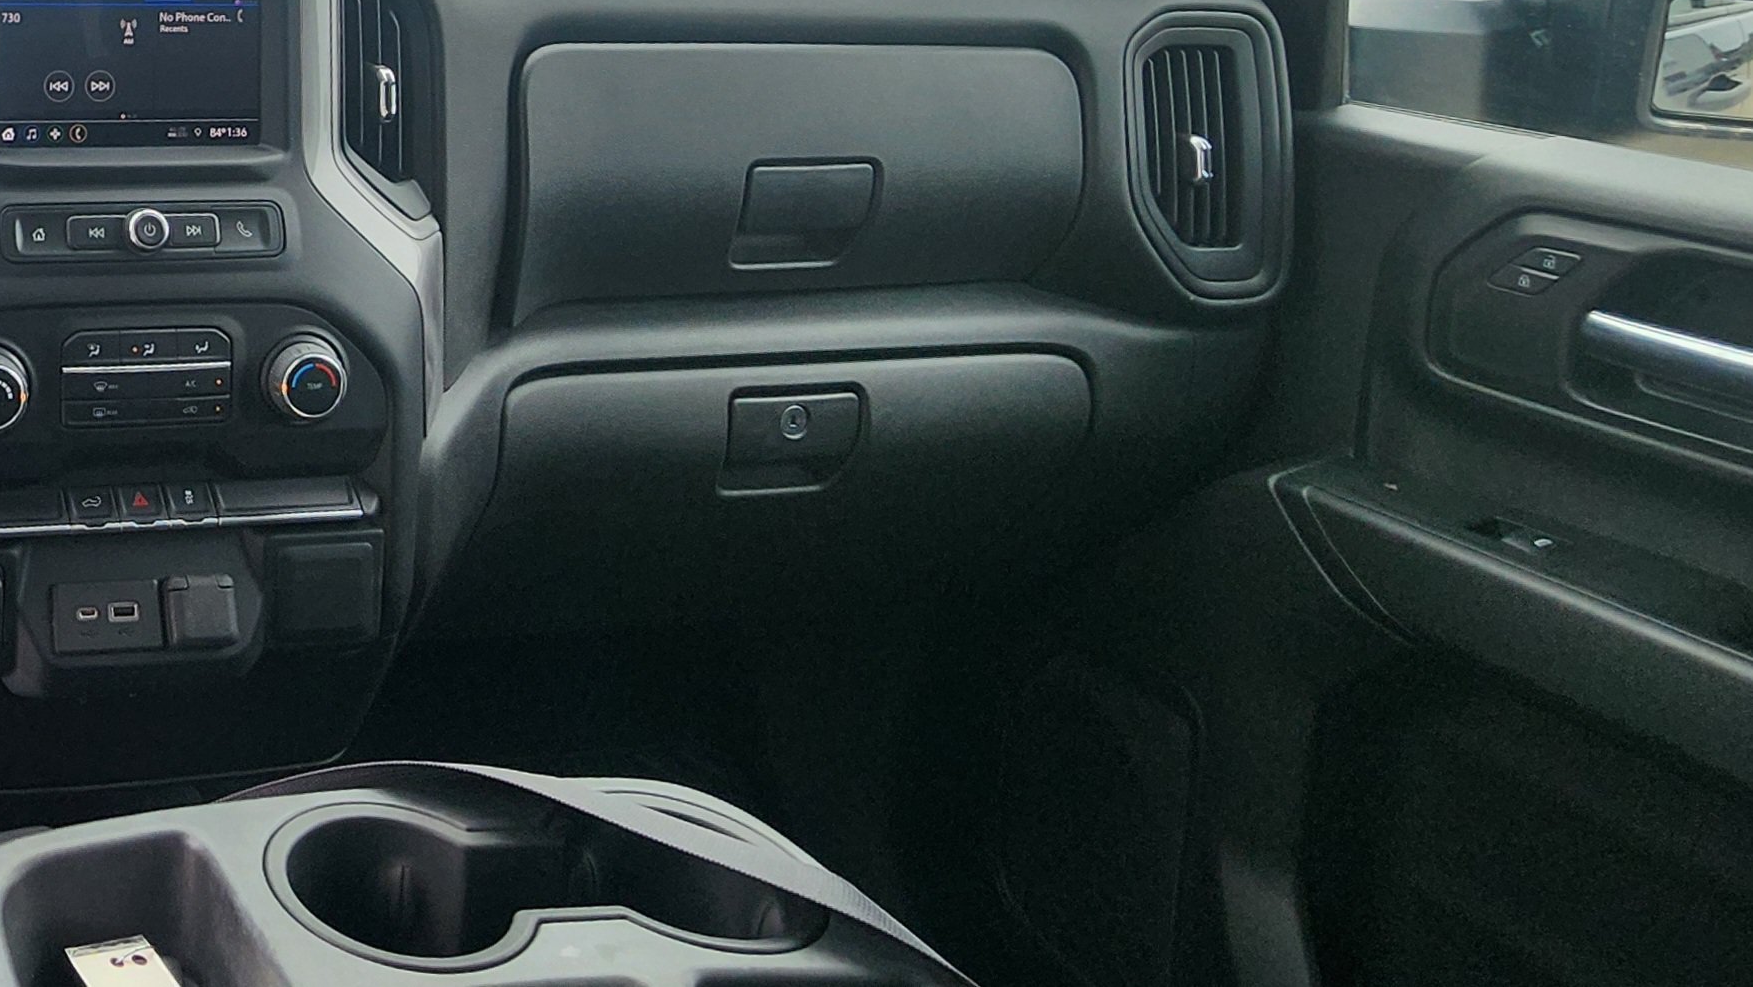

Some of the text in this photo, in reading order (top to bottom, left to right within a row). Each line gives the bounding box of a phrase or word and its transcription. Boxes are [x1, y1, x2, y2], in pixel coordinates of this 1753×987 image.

[1, 12, 22, 23] 730
[159, 12, 174, 23] No
[175, 12, 206, 23] Phone
[159, 24, 189, 33] Recents
[185, 380, 197, 388] A/C
[306, 382, 323, 390] TEMP
